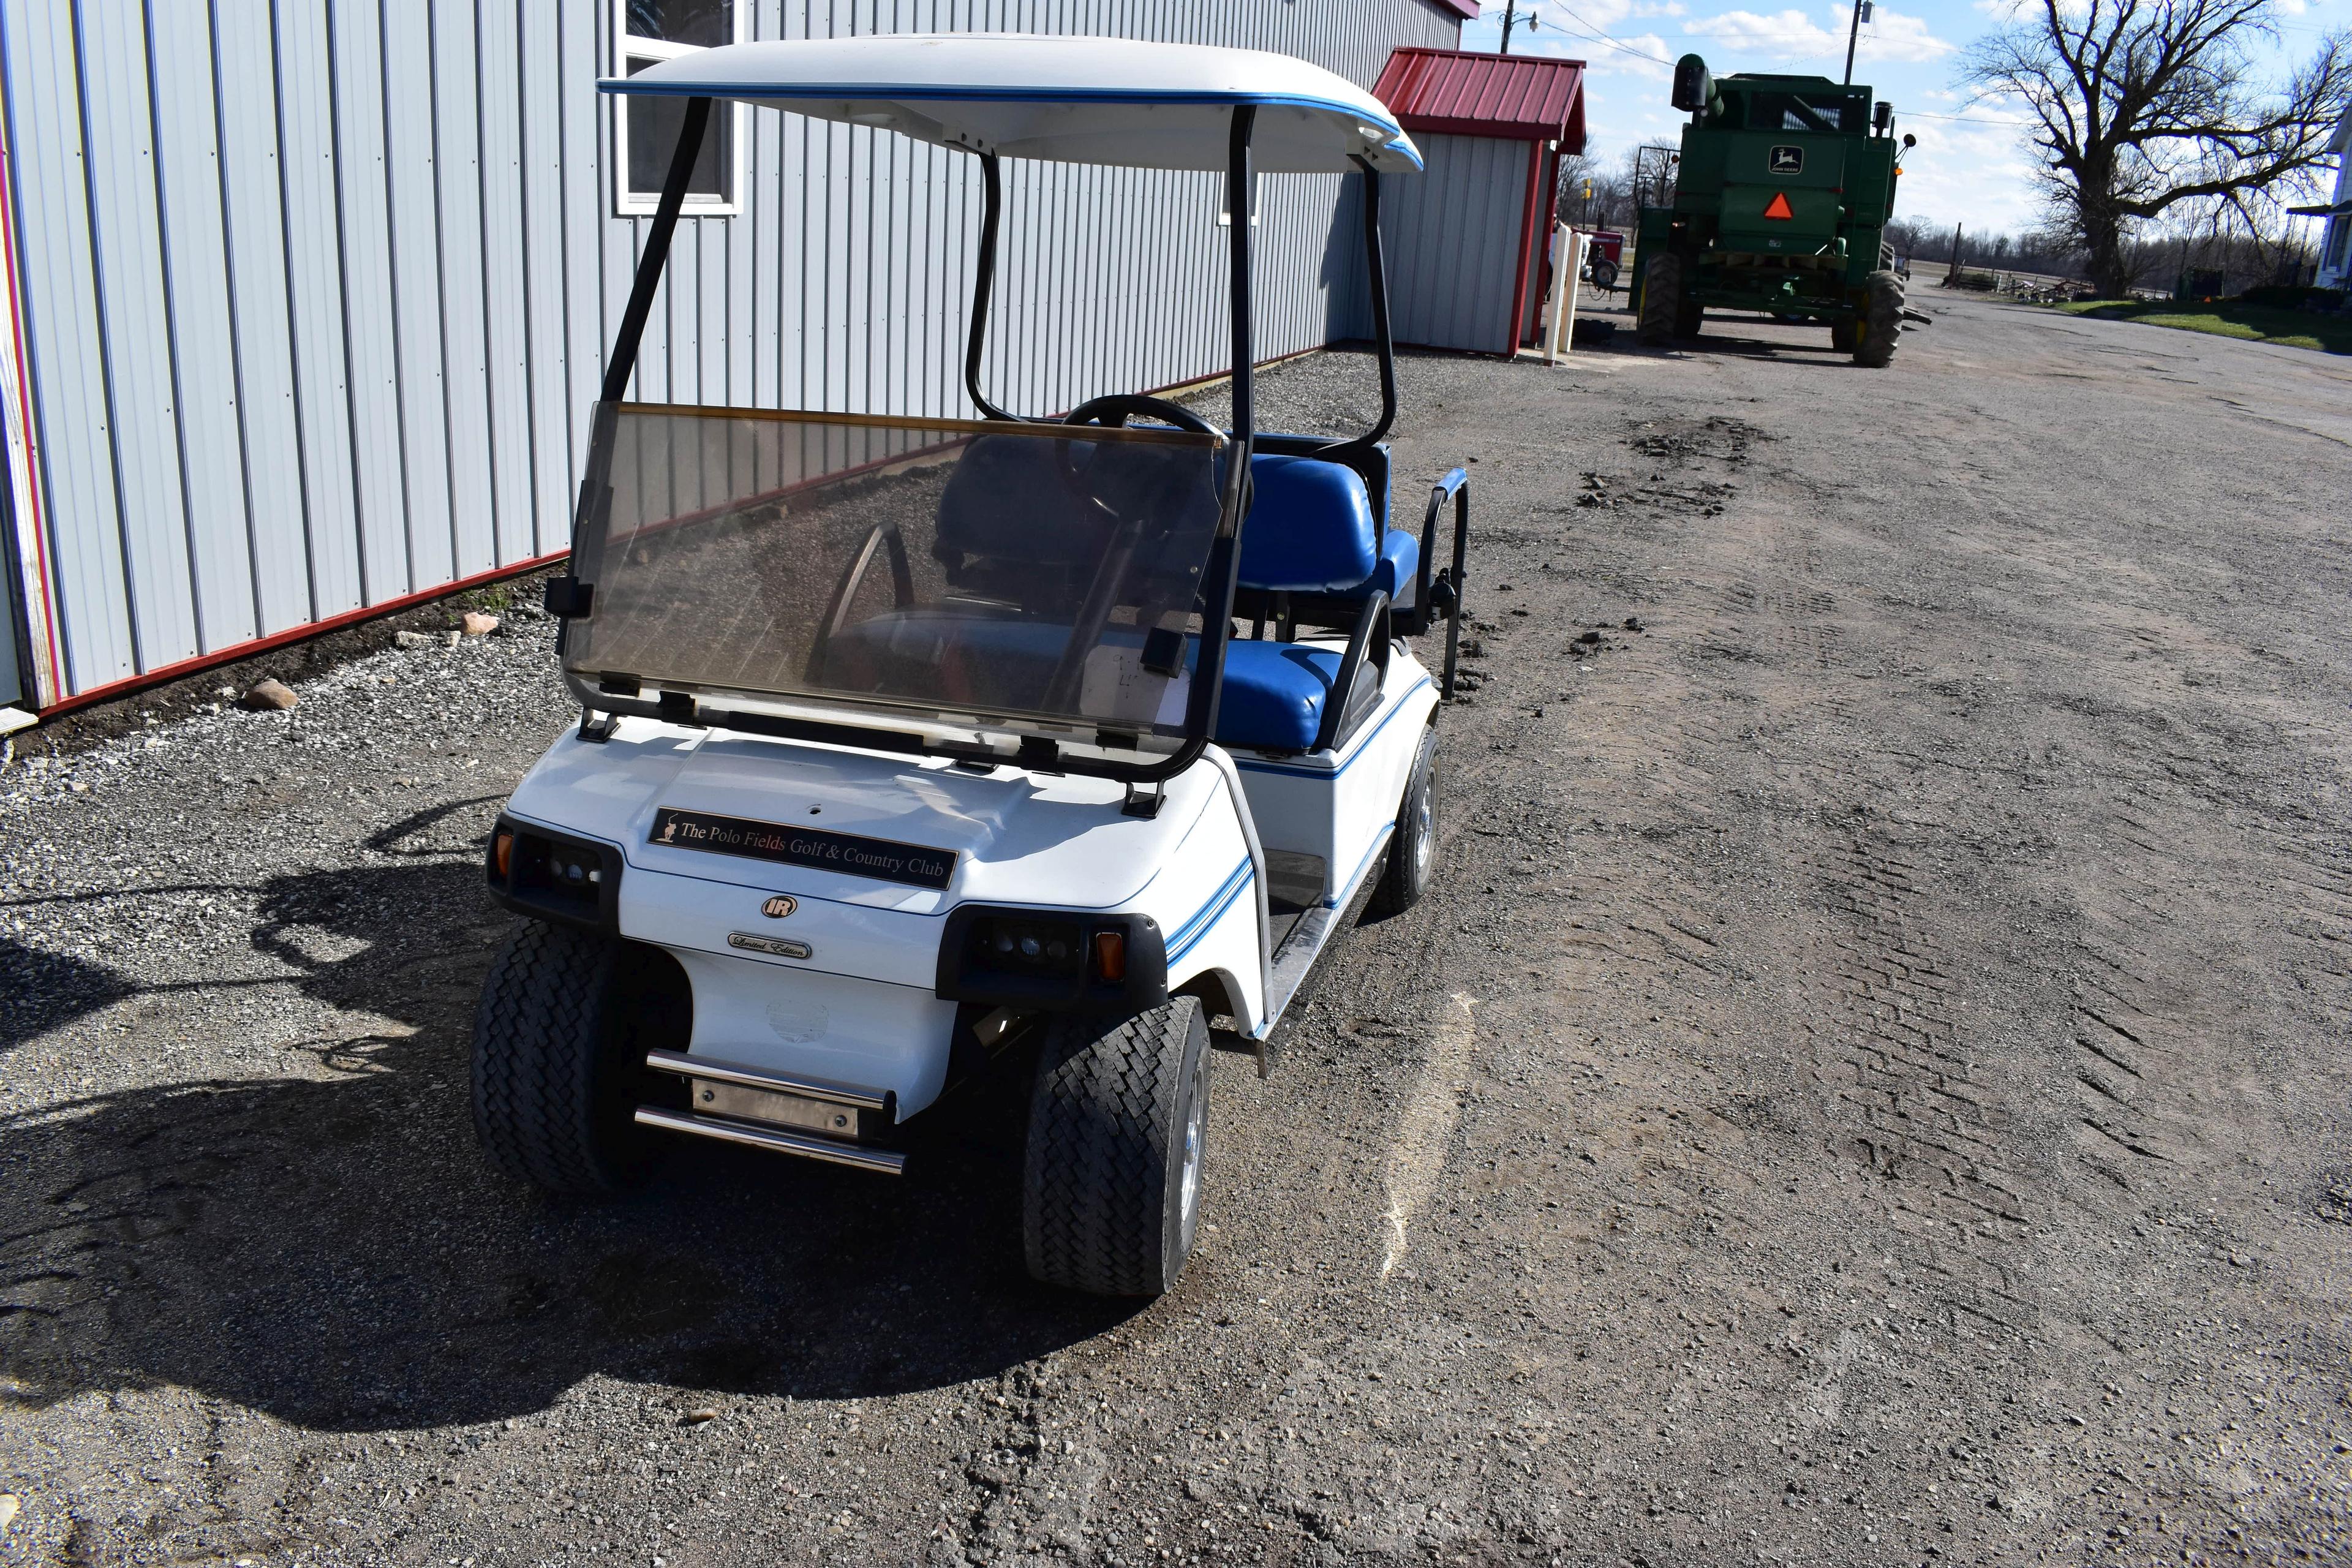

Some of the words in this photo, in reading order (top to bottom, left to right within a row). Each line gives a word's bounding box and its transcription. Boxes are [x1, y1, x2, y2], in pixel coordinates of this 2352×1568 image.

[681, 823, 706, 839] The
[708, 827, 741, 843] Polo
[743, 832, 786, 850] Fields
[790, 839, 826, 856] Golf
[826, 845, 840, 859] &
[844, 848, 904, 873] Country
[908, 858, 944, 876] Club
[766, 899, 791, 916] IR
[733, 936, 766, 950] Limited
[771, 943, 804, 957] Edition
